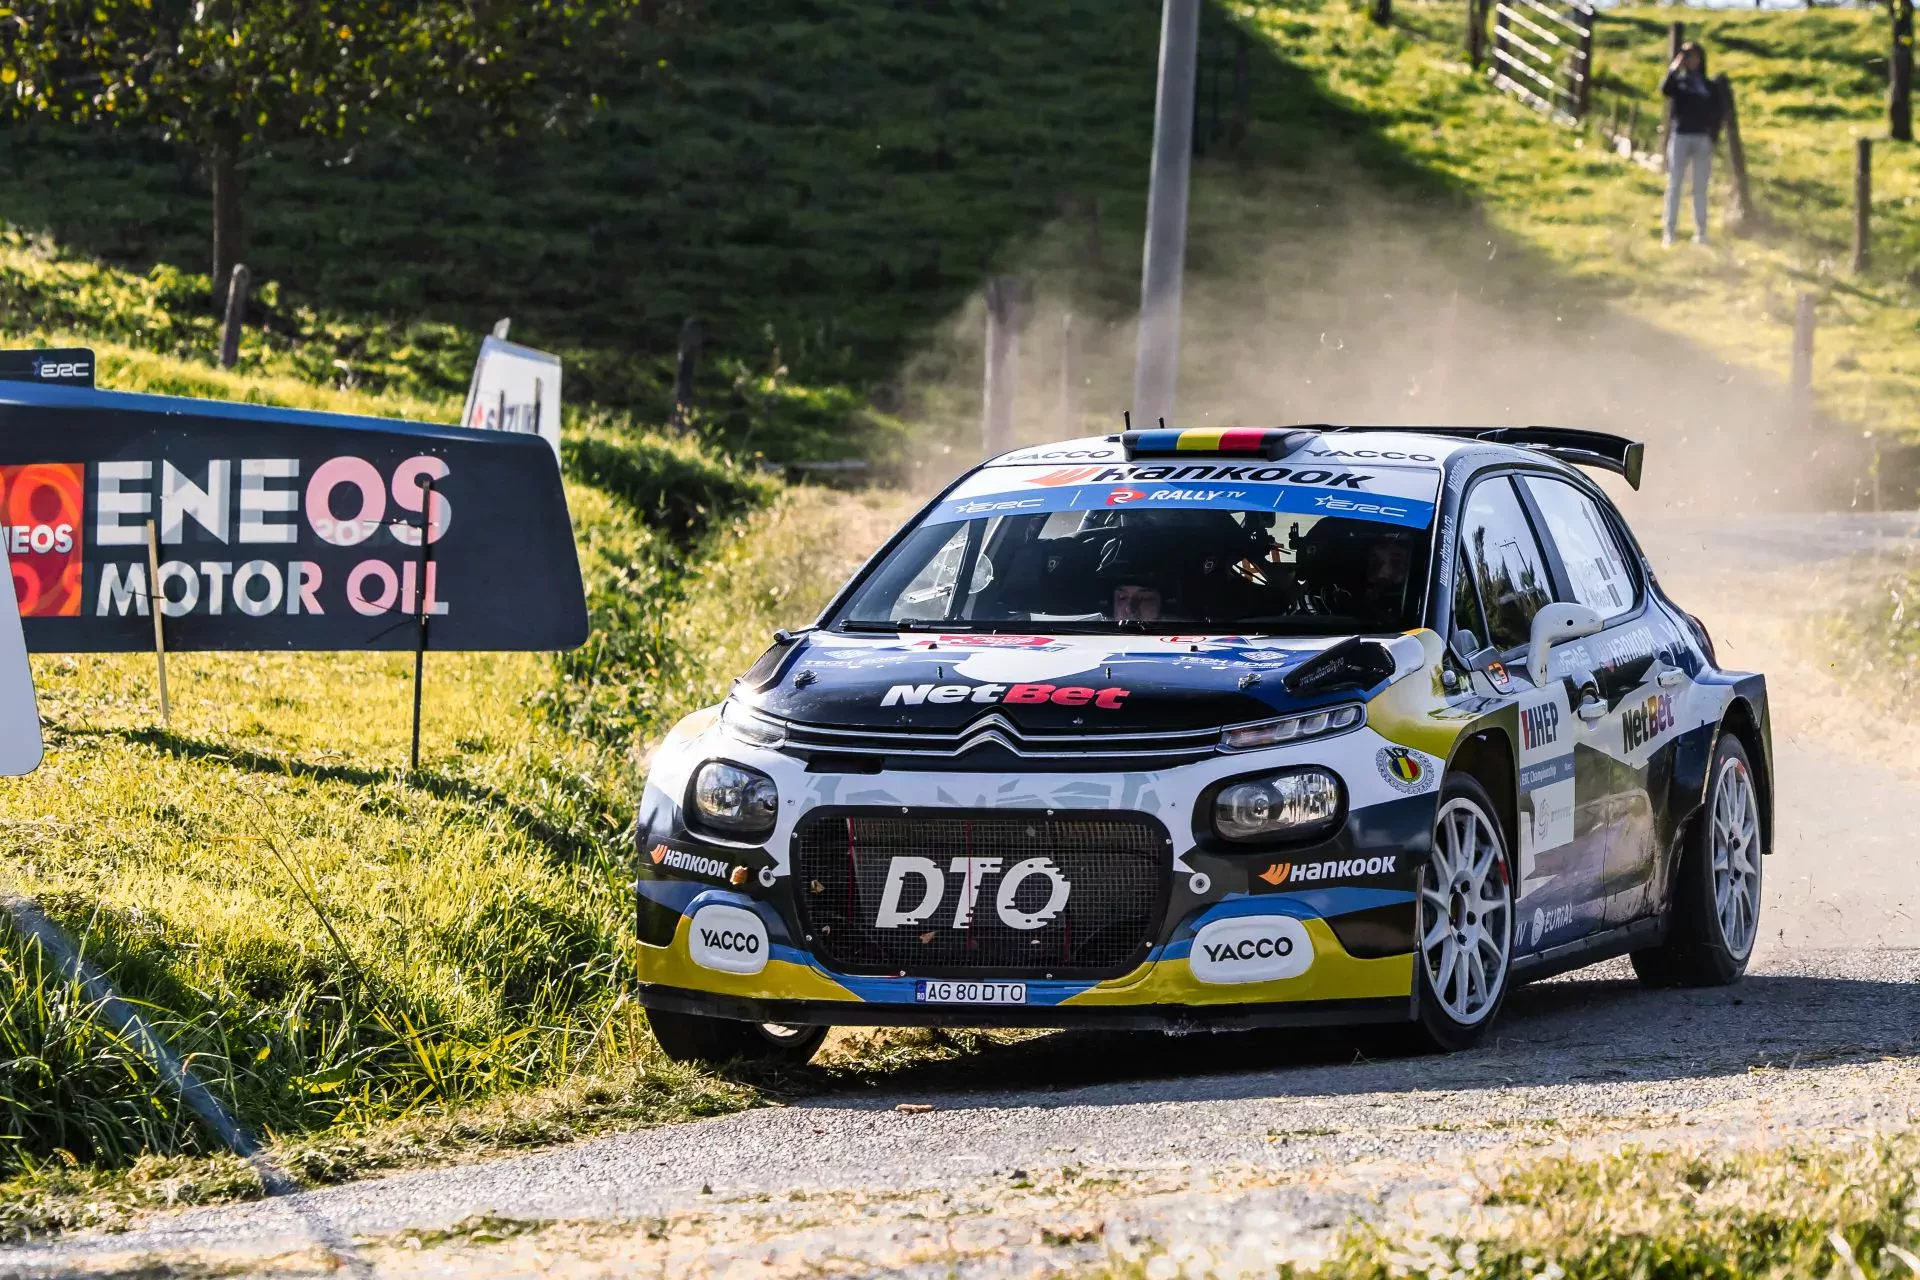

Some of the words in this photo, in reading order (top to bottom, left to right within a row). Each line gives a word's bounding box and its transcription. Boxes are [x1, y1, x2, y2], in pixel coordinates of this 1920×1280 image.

[1304, 450, 1436, 462] YACCO
[96, 455, 452, 547] ENEOS
[1149, 490, 1224, 501] RALLY
[96, 559, 325, 618] MOTOR
[346, 559, 449, 618] OIL
[880, 684, 1131, 710] NetBet
[1621, 692, 1675, 755] NetBet
[875, 856, 1071, 930] DTO
[701, 929, 759, 954] YACCO
[1203, 937, 1293, 963] YACCO
[928, 983, 951, 1001] AG
[956, 984, 978, 1001] 80
[983, 985, 1023, 1002] DTO
